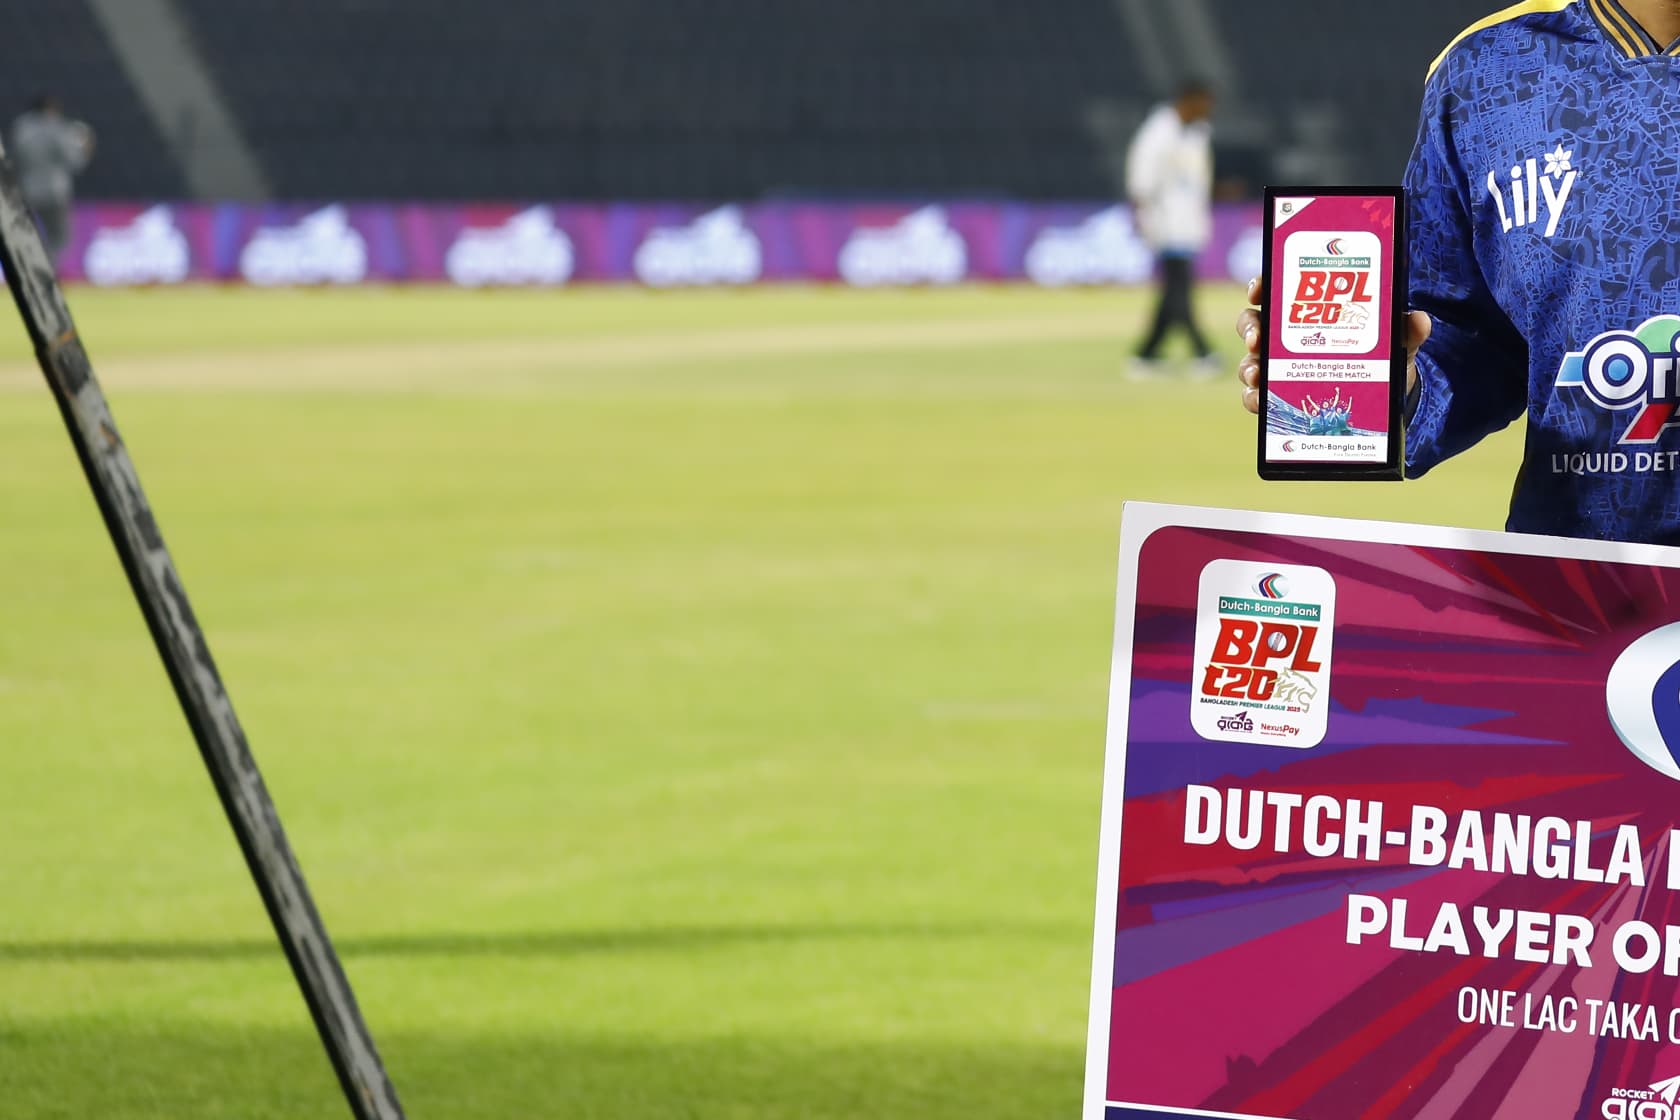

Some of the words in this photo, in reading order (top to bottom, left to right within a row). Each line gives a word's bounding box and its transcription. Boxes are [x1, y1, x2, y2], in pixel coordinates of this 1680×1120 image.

[1487, 158, 1577, 237] Lily
[1299, 258, 1349, 267] Dutch-Bangla
[1294, 271, 1372, 302] BPL
[1291, 362, 1344, 371] Dutch-Bangla
[1346, 362, 1366, 370] Bank
[1317, 371, 1328, 379] OF
[1301, 442, 1354, 452] Dutch-Bangla
[1357, 443, 1376, 451] Bank
[1551, 451, 1627, 476] LIQUID
[1220, 600, 1290, 617] Dutch-Bangla
[1292, 605, 1319, 618] Bank
[1210, 618, 1323, 672] BPL
[1200, 697, 1238, 707] BANGLADESH
[1239, 701, 1263, 709] PREMIER
[1264, 703, 1286, 711] LEAGUE
[1261, 722, 1300, 736] NexusPay
[1183, 784, 1646, 887] DUTCH-BANGLA
[1346, 894, 1595, 968] PLAYER
[1458, 986, 1516, 1027] ONE
[1523, 993, 1578, 1033] LAC
[1585, 999, 1660, 1042] TAKA
[1611, 1087, 1655, 1101] ROCKET
